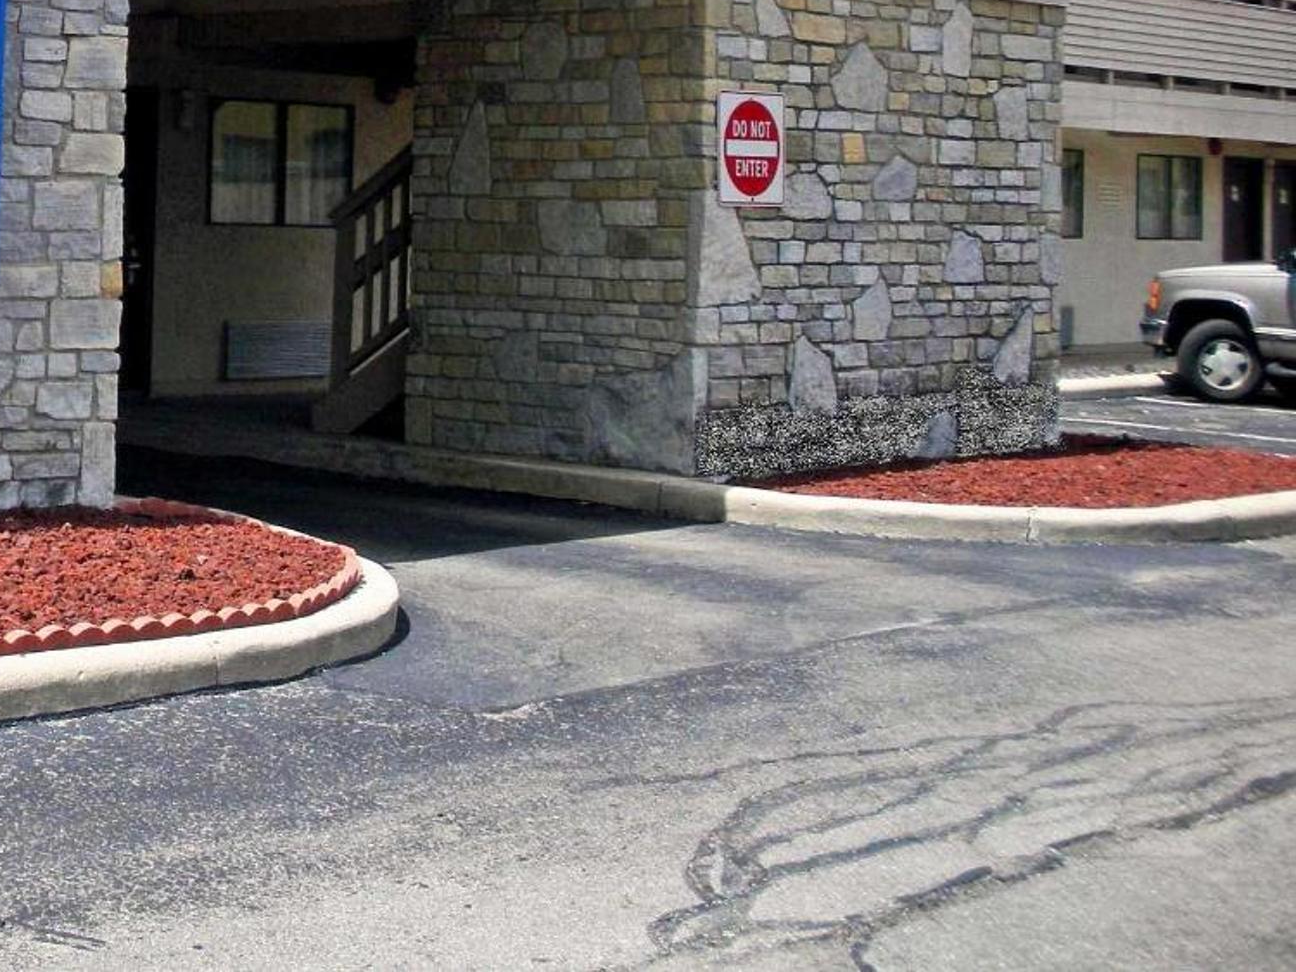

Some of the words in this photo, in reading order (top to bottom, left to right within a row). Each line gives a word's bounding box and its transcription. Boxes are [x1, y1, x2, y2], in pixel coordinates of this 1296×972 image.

[732, 119, 747, 137] DO
[750, 120, 771, 138] NOT
[735, 159, 769, 178] ENTER
